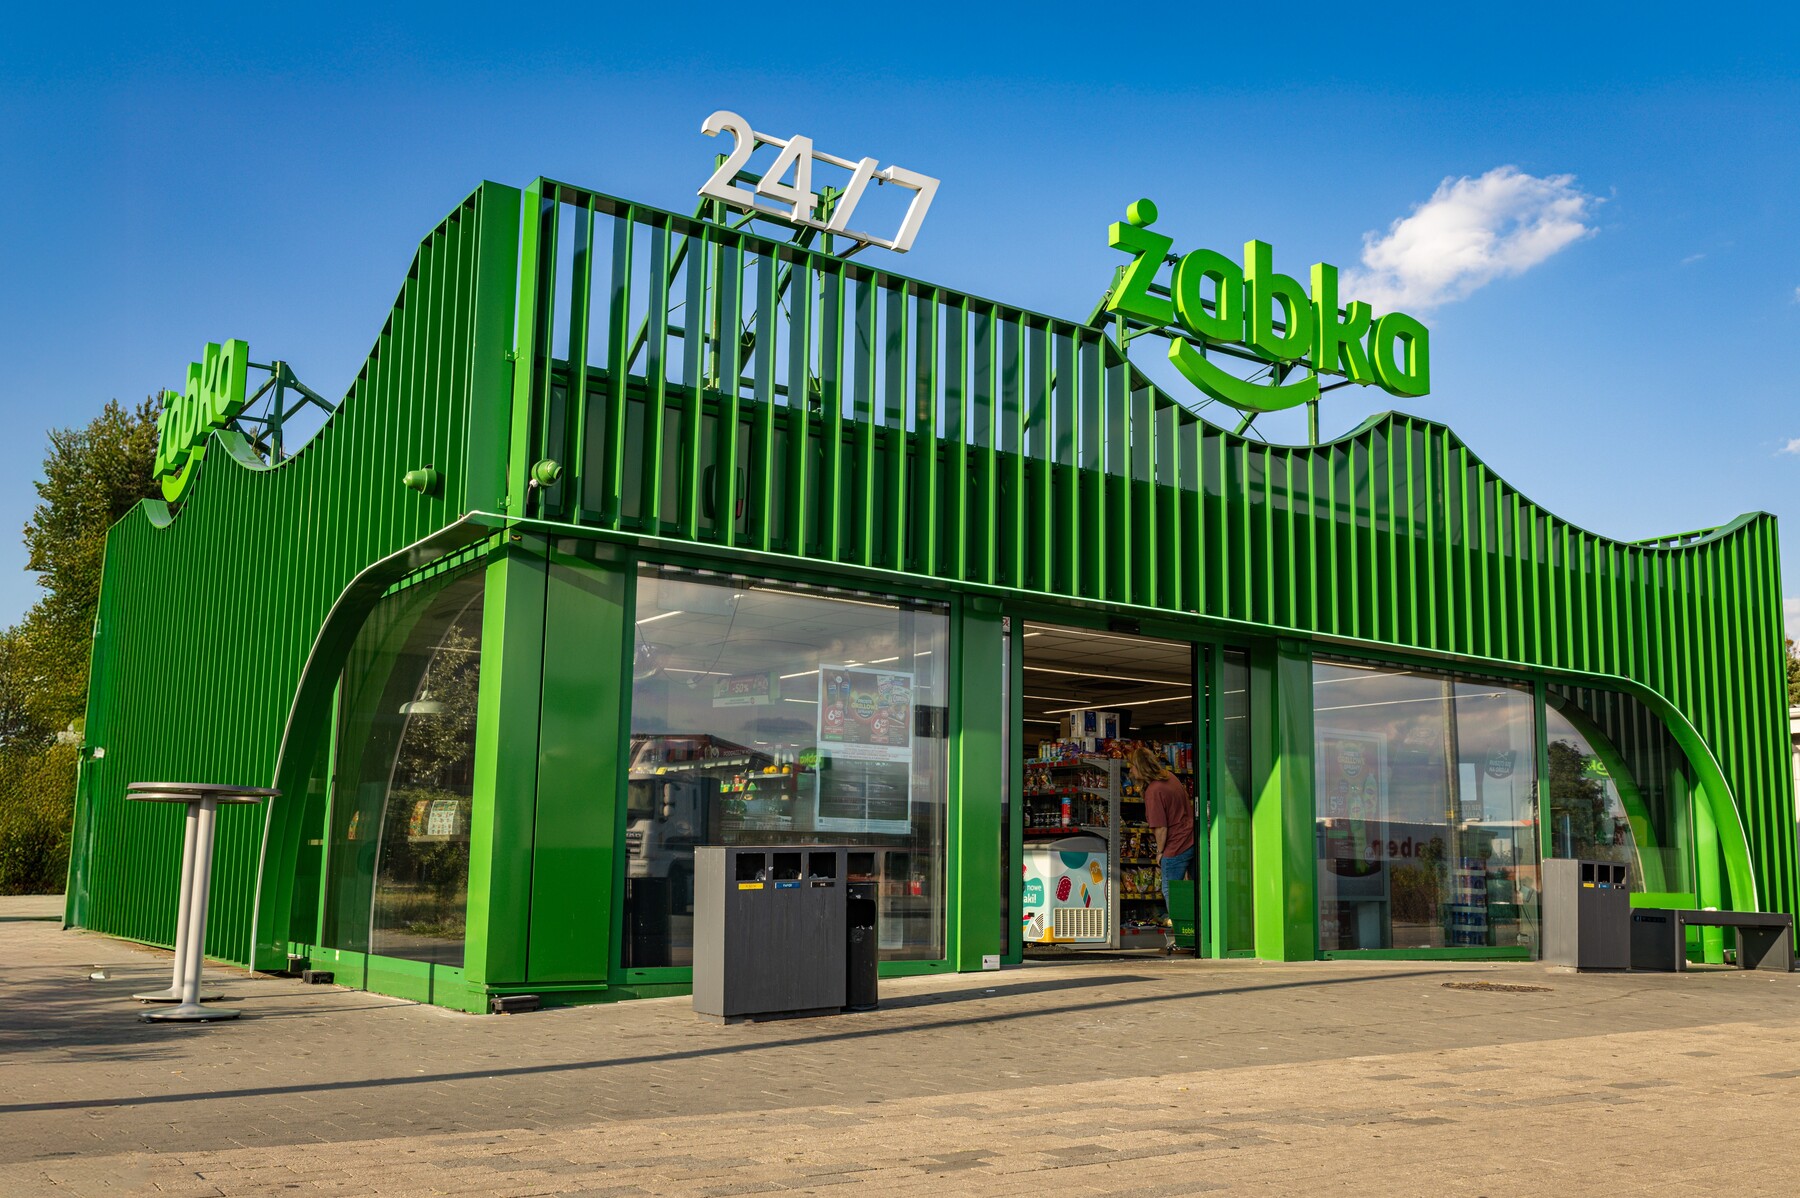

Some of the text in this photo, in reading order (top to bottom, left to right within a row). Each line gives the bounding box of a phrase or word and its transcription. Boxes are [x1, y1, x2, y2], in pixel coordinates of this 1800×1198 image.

[698, 110, 940, 253] 24/7
[1107, 198, 1430, 398] żabka
[153, 338, 248, 480] żabka
